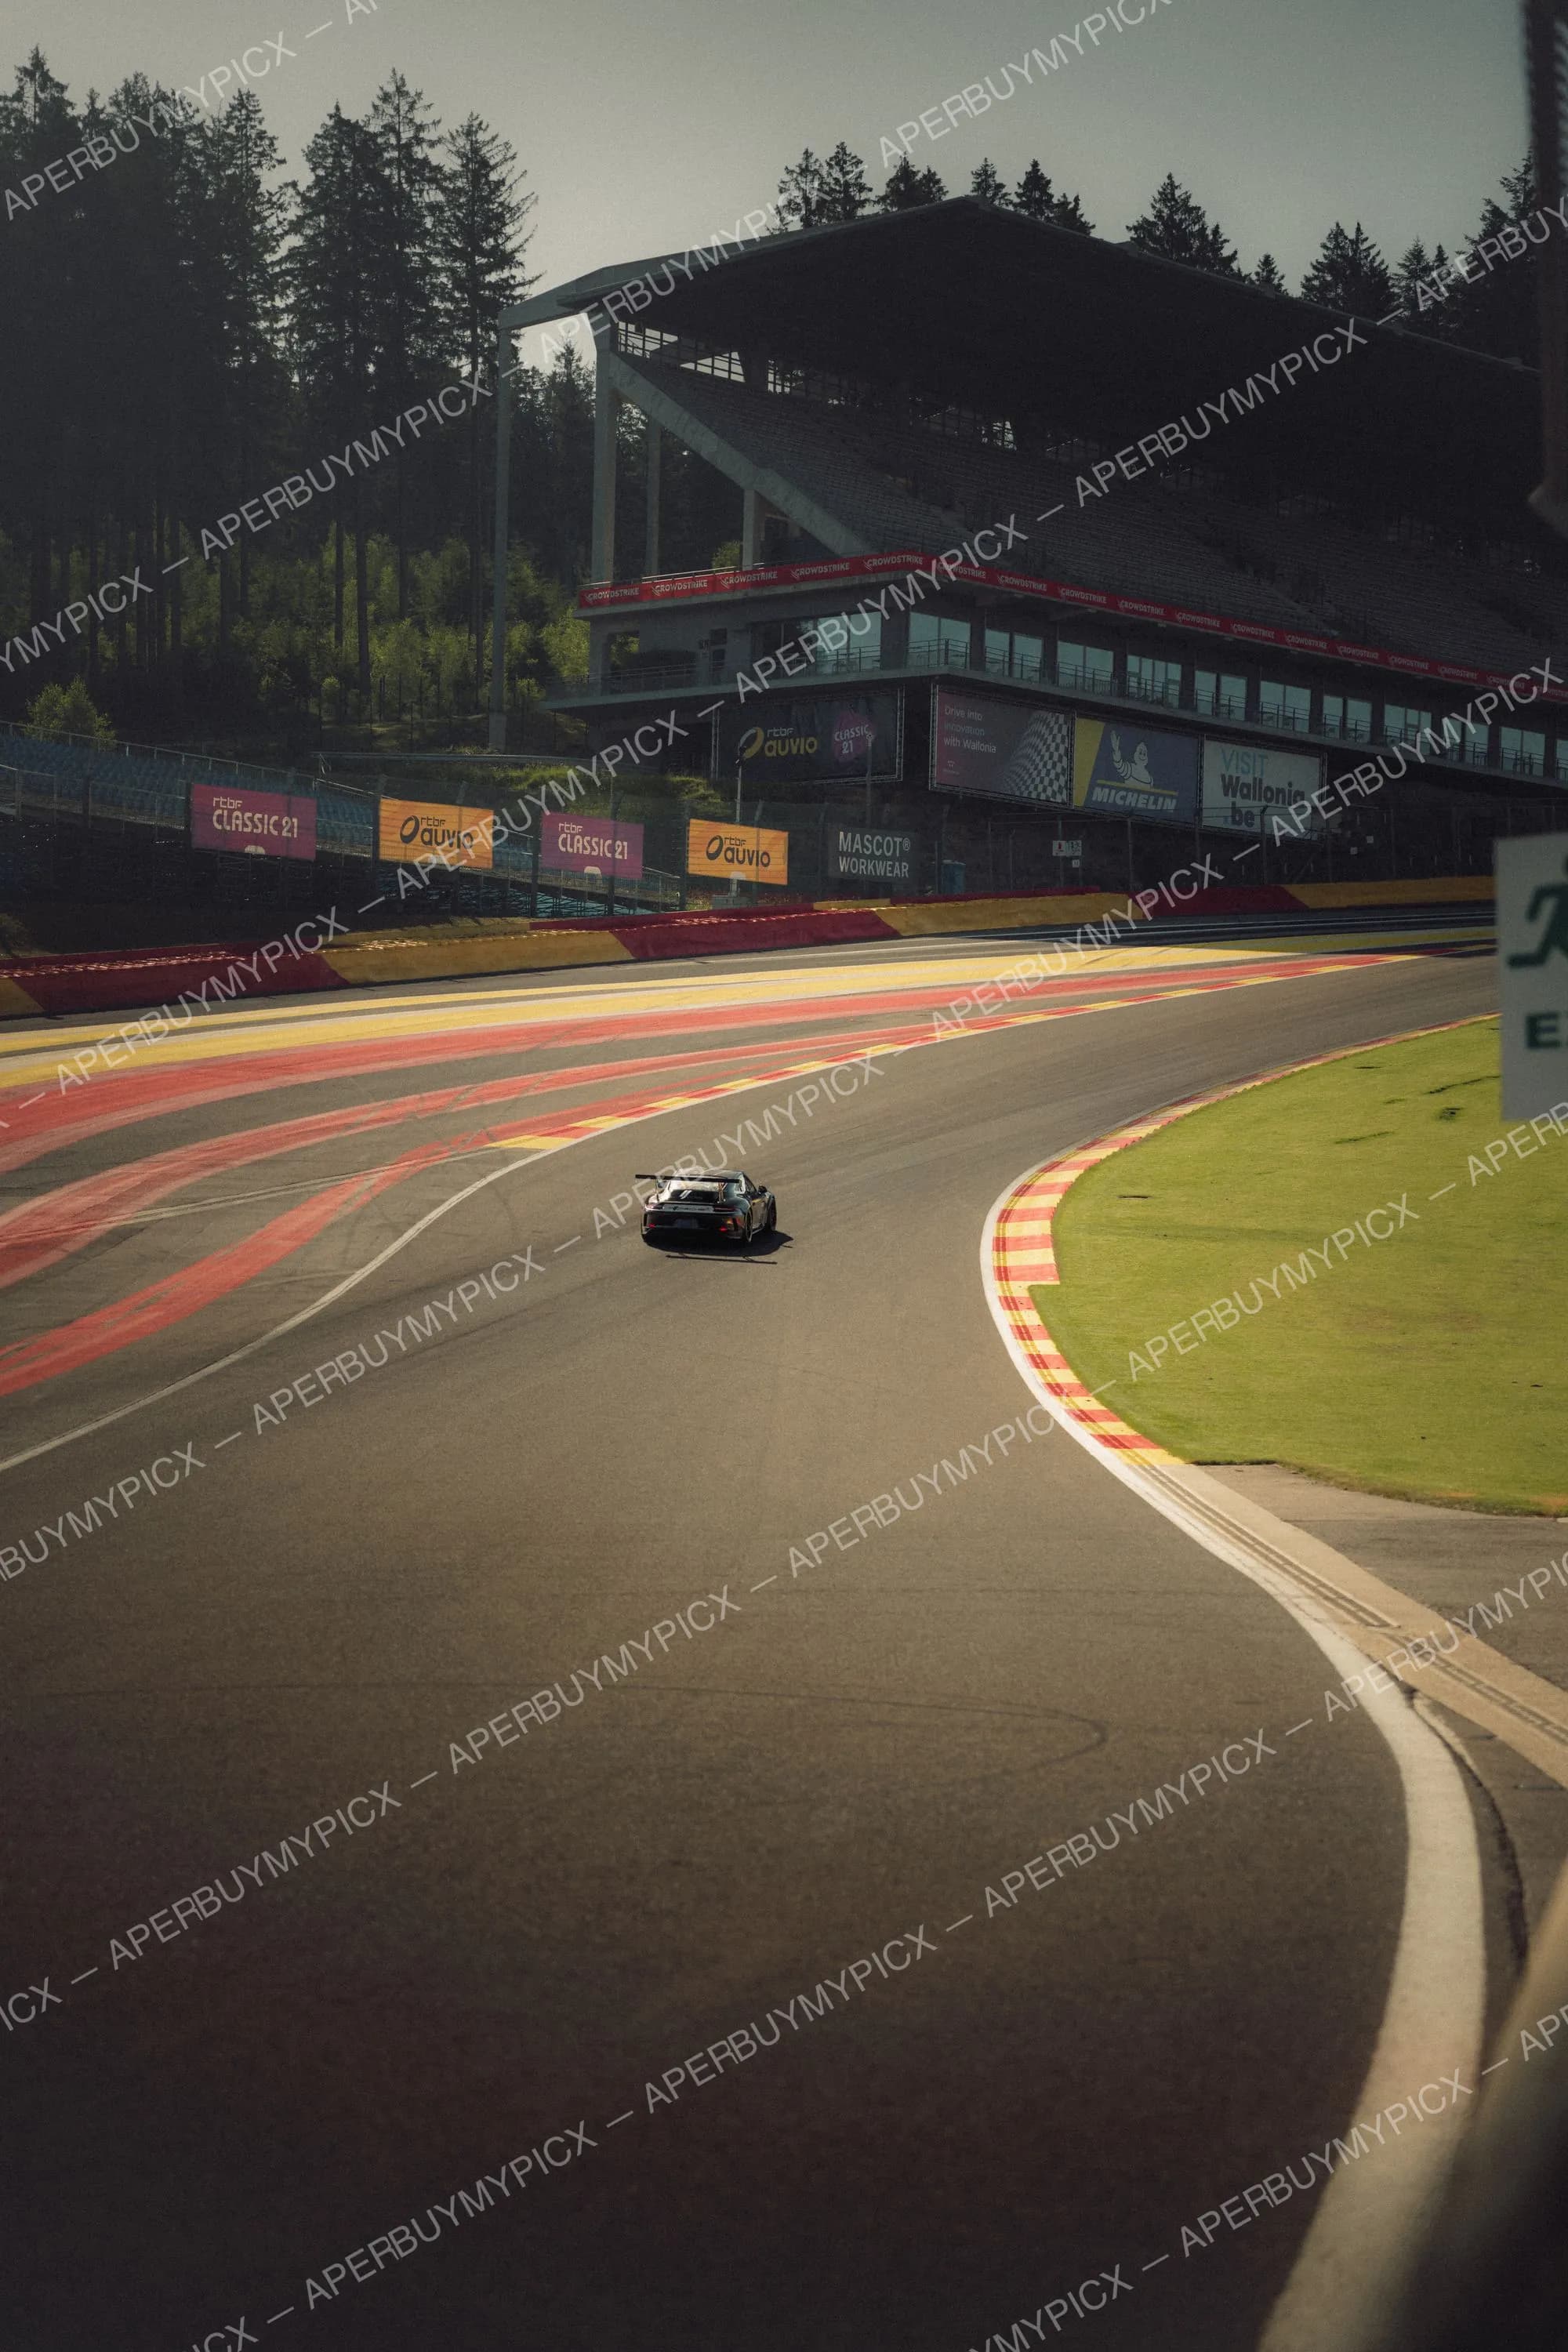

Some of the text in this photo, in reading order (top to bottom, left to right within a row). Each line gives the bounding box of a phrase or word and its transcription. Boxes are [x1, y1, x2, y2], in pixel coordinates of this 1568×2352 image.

[587, 554, 924, 601] CROWDSTRIKE CROWDSTRIKE CROWDSTRIKE CROWDSTRIKE CROWDSTRIKE
[938, 561, 987, 579] CWDSTRIKE
[999, 574, 1047, 592] CROWDSTRIKE
[1060, 587, 1108, 604] CROWDSTRIKE
[1119, 599, 1165, 616] CROWDSTRIKE
[1177, 612, 1221, 628] CROWDSTRIKE
[944, 706, 983, 721] Drive into
[834, 724, 870, 742] CLASSIC
[943, 735, 997, 754] with Wallonia
[764, 737, 818, 757] auvio
[841, 740, 854, 754] 21
[1221, 750, 1269, 778] VISIT
[1092, 786, 1177, 812] MICHELIN
[1221, 774, 1305, 807] Wallonia
[212, 809, 298, 839] CLASSIC 21
[420, 827, 474, 850] auvio
[558, 833, 628, 860] CLASSIC 21
[724, 847, 771, 868] auvio
[838, 856, 909, 878] WORKWEAR
